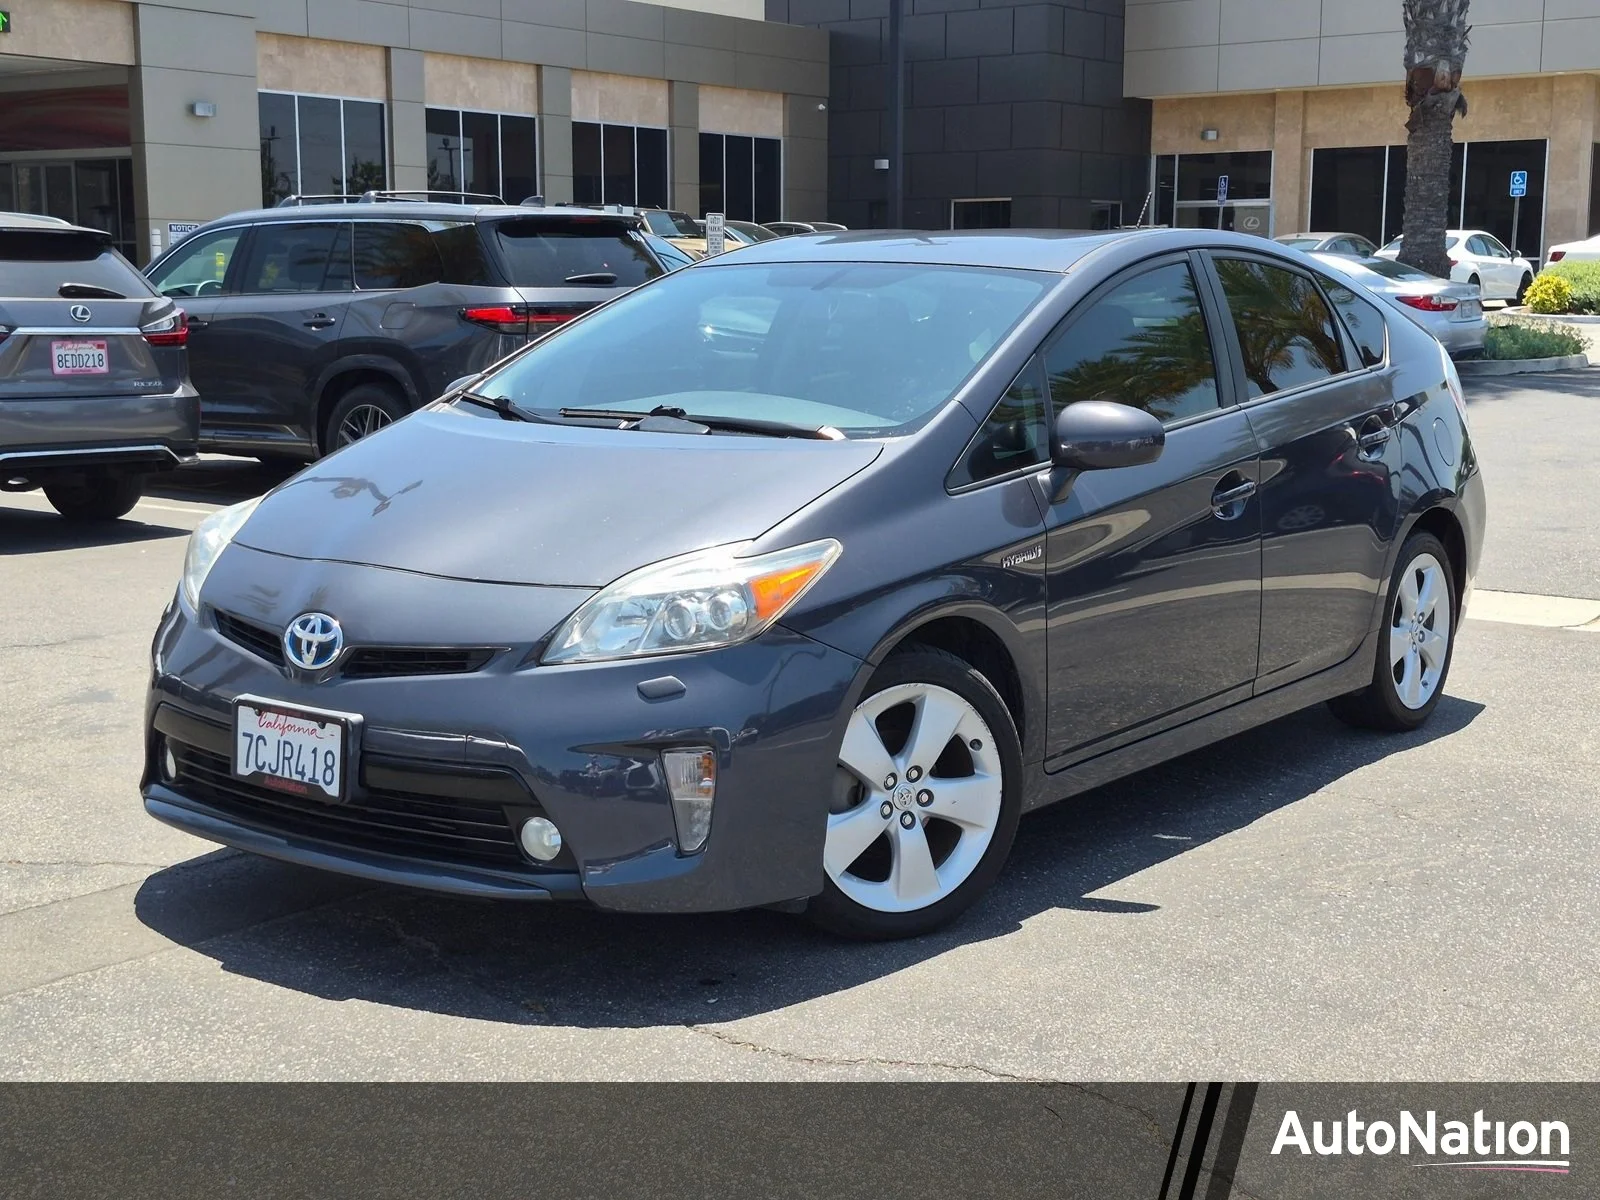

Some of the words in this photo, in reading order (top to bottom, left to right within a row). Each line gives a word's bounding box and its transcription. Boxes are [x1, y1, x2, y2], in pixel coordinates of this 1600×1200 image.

[57, 353, 105, 369] 8EDD218
[257, 710, 325, 739] California
[242, 731, 336, 787] 7CJR418
